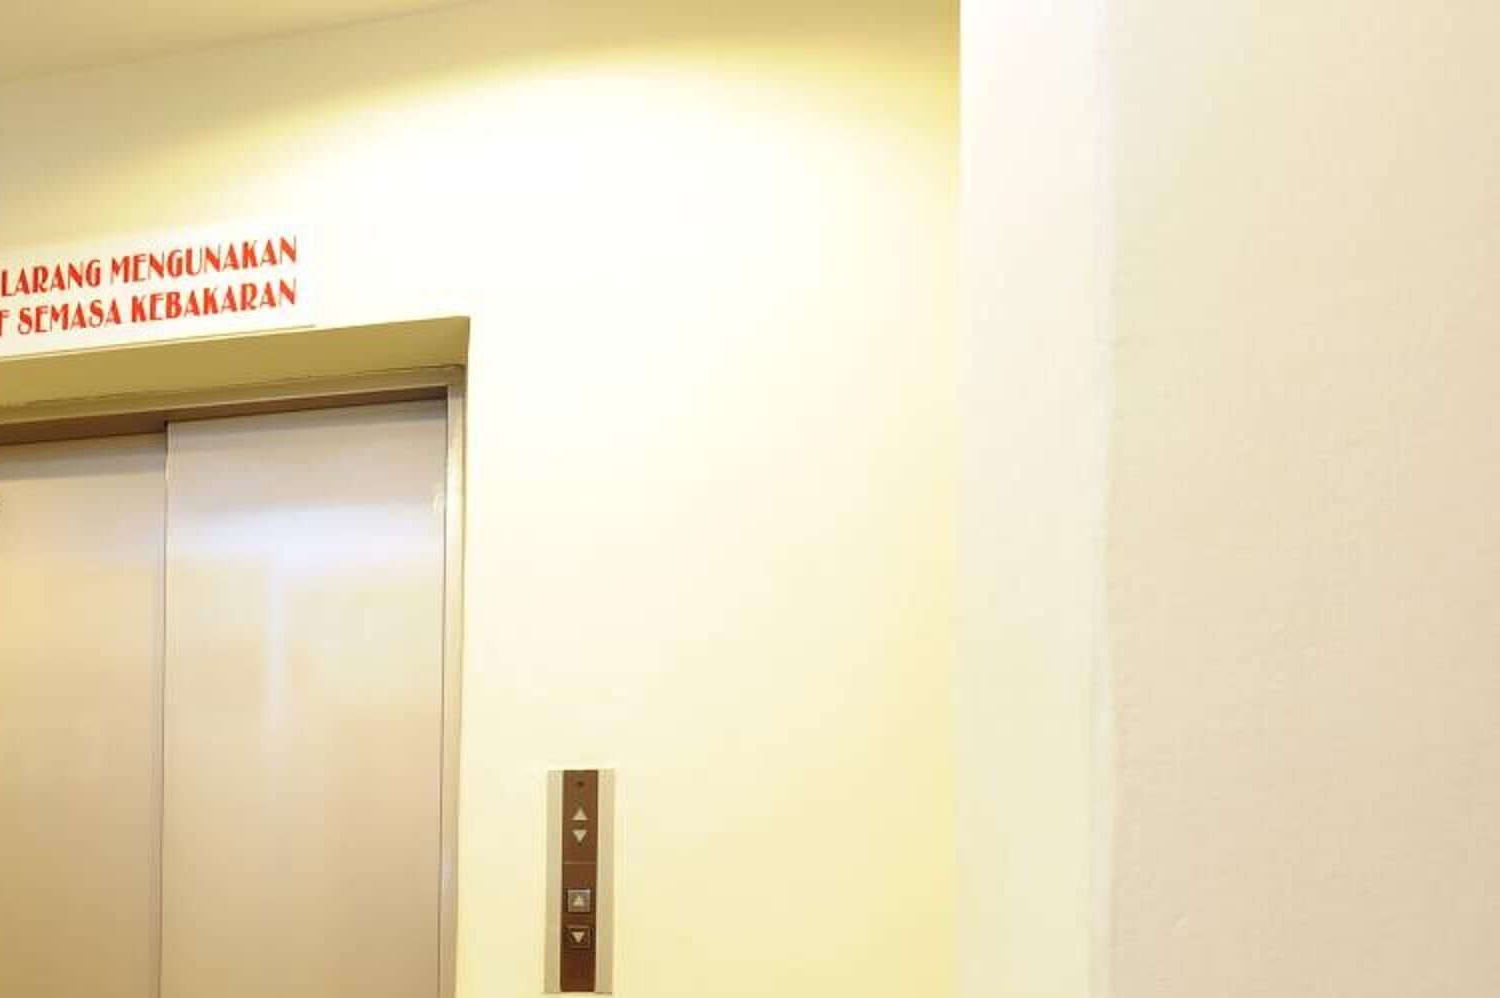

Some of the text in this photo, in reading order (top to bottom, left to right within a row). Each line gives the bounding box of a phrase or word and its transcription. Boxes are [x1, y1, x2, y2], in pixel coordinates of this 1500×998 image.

[110, 235, 297, 284] MENGUNAKAN
[17, 299, 122, 335] SEMASA
[131, 278, 297, 323] KEBAKARAN
